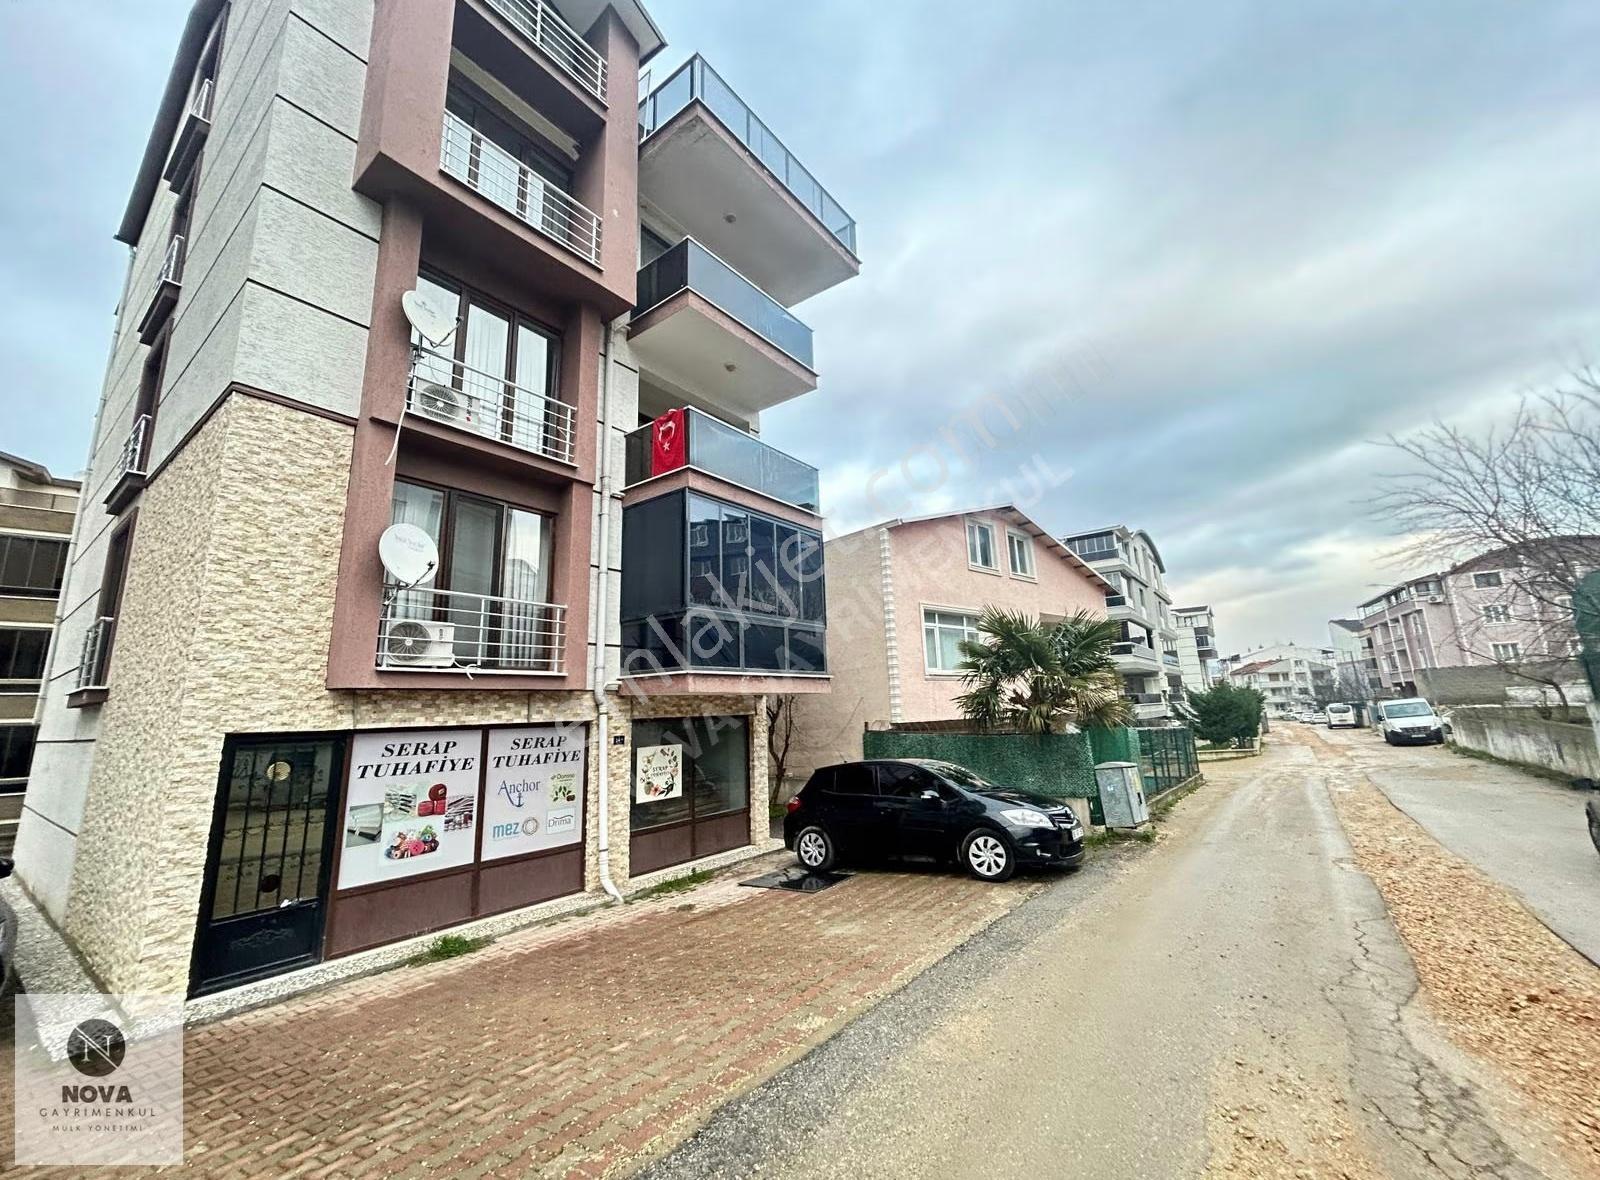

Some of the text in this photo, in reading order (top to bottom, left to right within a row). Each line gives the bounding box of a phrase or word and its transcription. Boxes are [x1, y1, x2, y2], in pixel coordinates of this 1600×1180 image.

[381, 740, 457, 758] SERAP
[510, 735, 567, 751] SERAP
[357, 756, 474, 780] TUHAFİYE
[492, 748, 581, 769] TUHAFİYE
[498, 779, 541, 807] Anchor
[492, 822, 521, 839] mez
